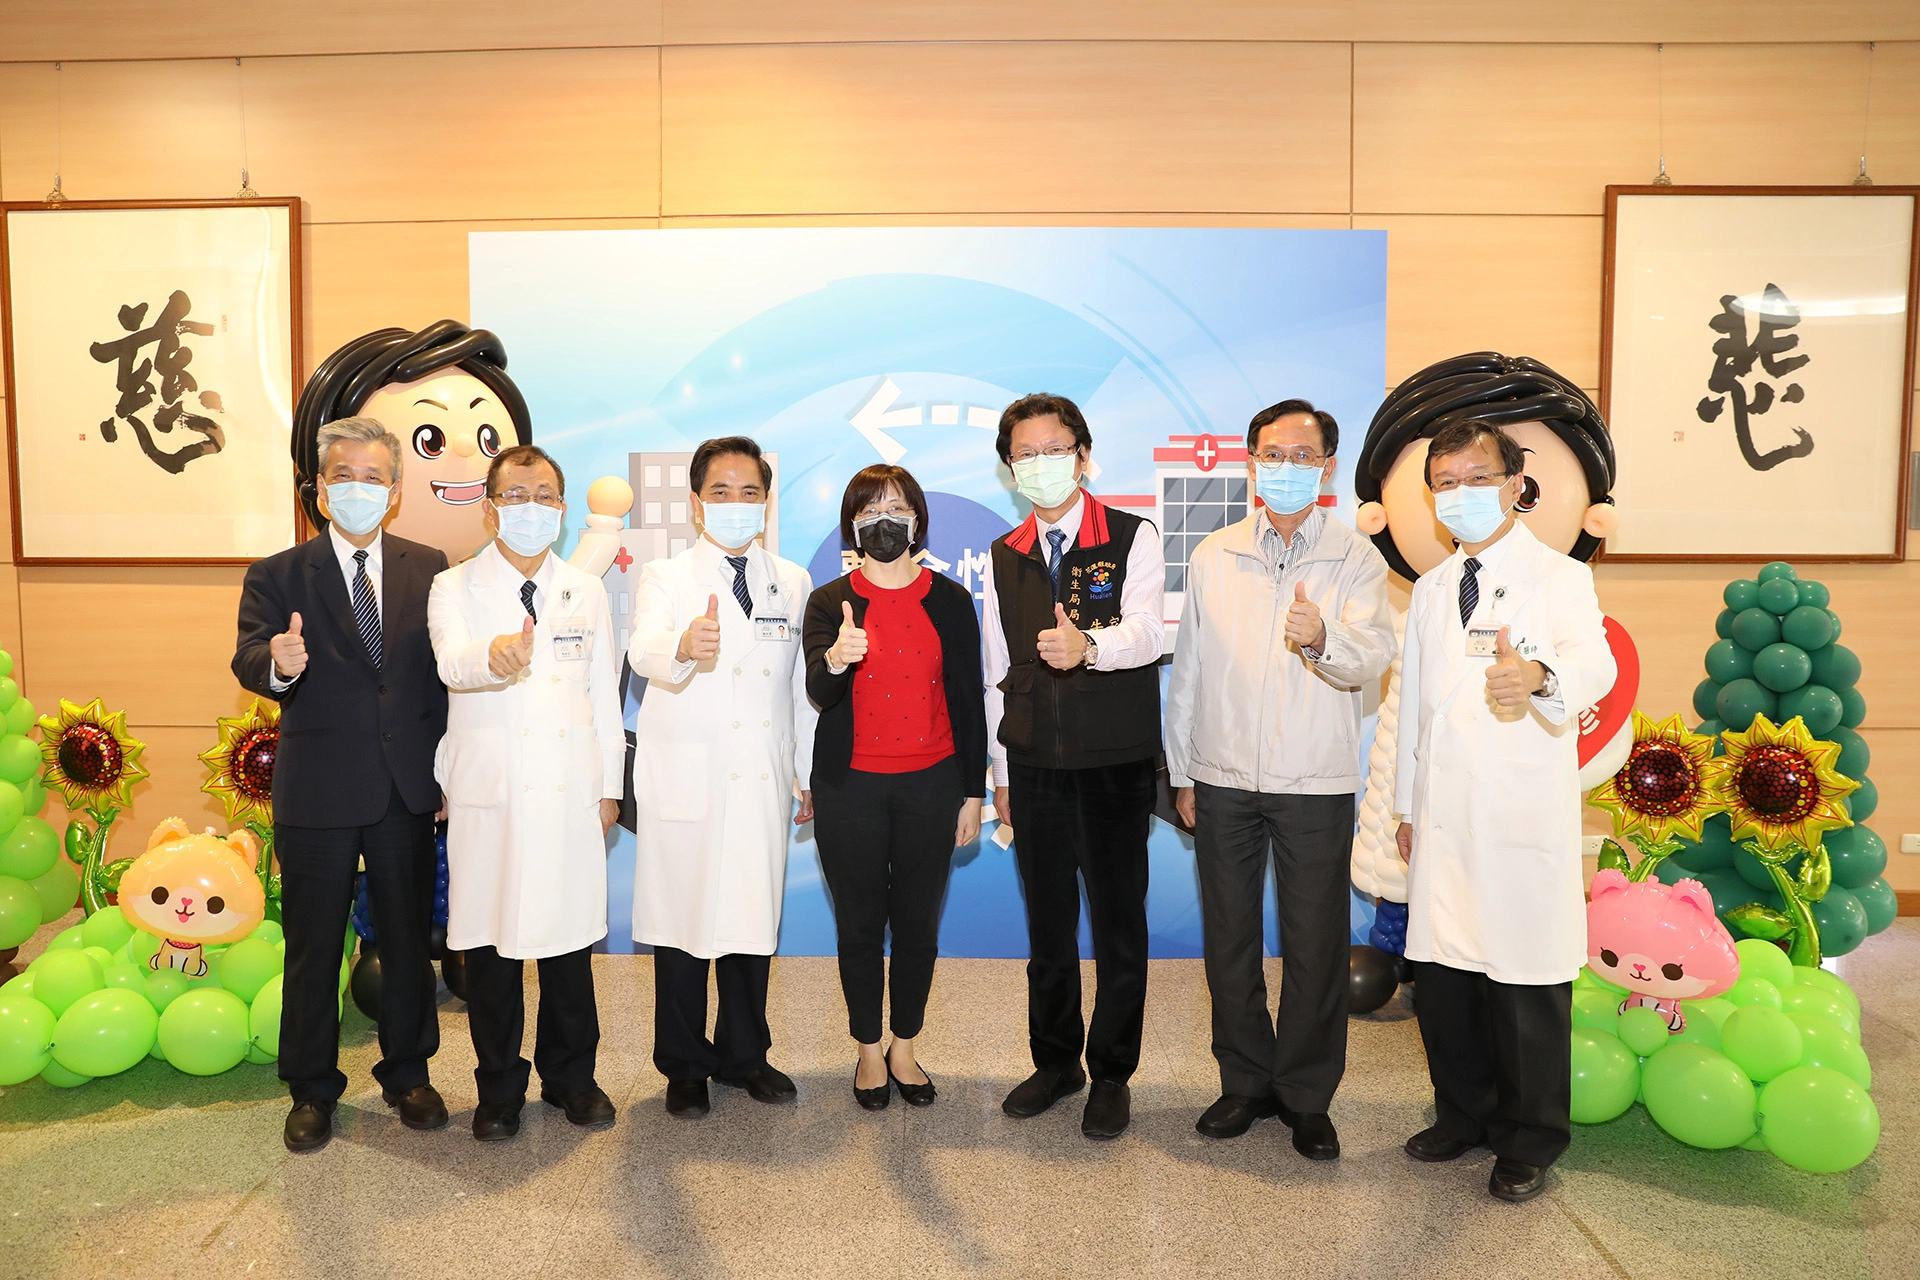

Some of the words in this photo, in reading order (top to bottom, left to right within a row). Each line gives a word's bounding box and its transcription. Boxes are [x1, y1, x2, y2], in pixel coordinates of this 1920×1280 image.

[89, 289, 226, 475] 慈
[1696, 282, 1815, 472] 悲
[1068, 566, 1082, 626] 衛生局局
[1090, 592, 1112, 600] Hualien
